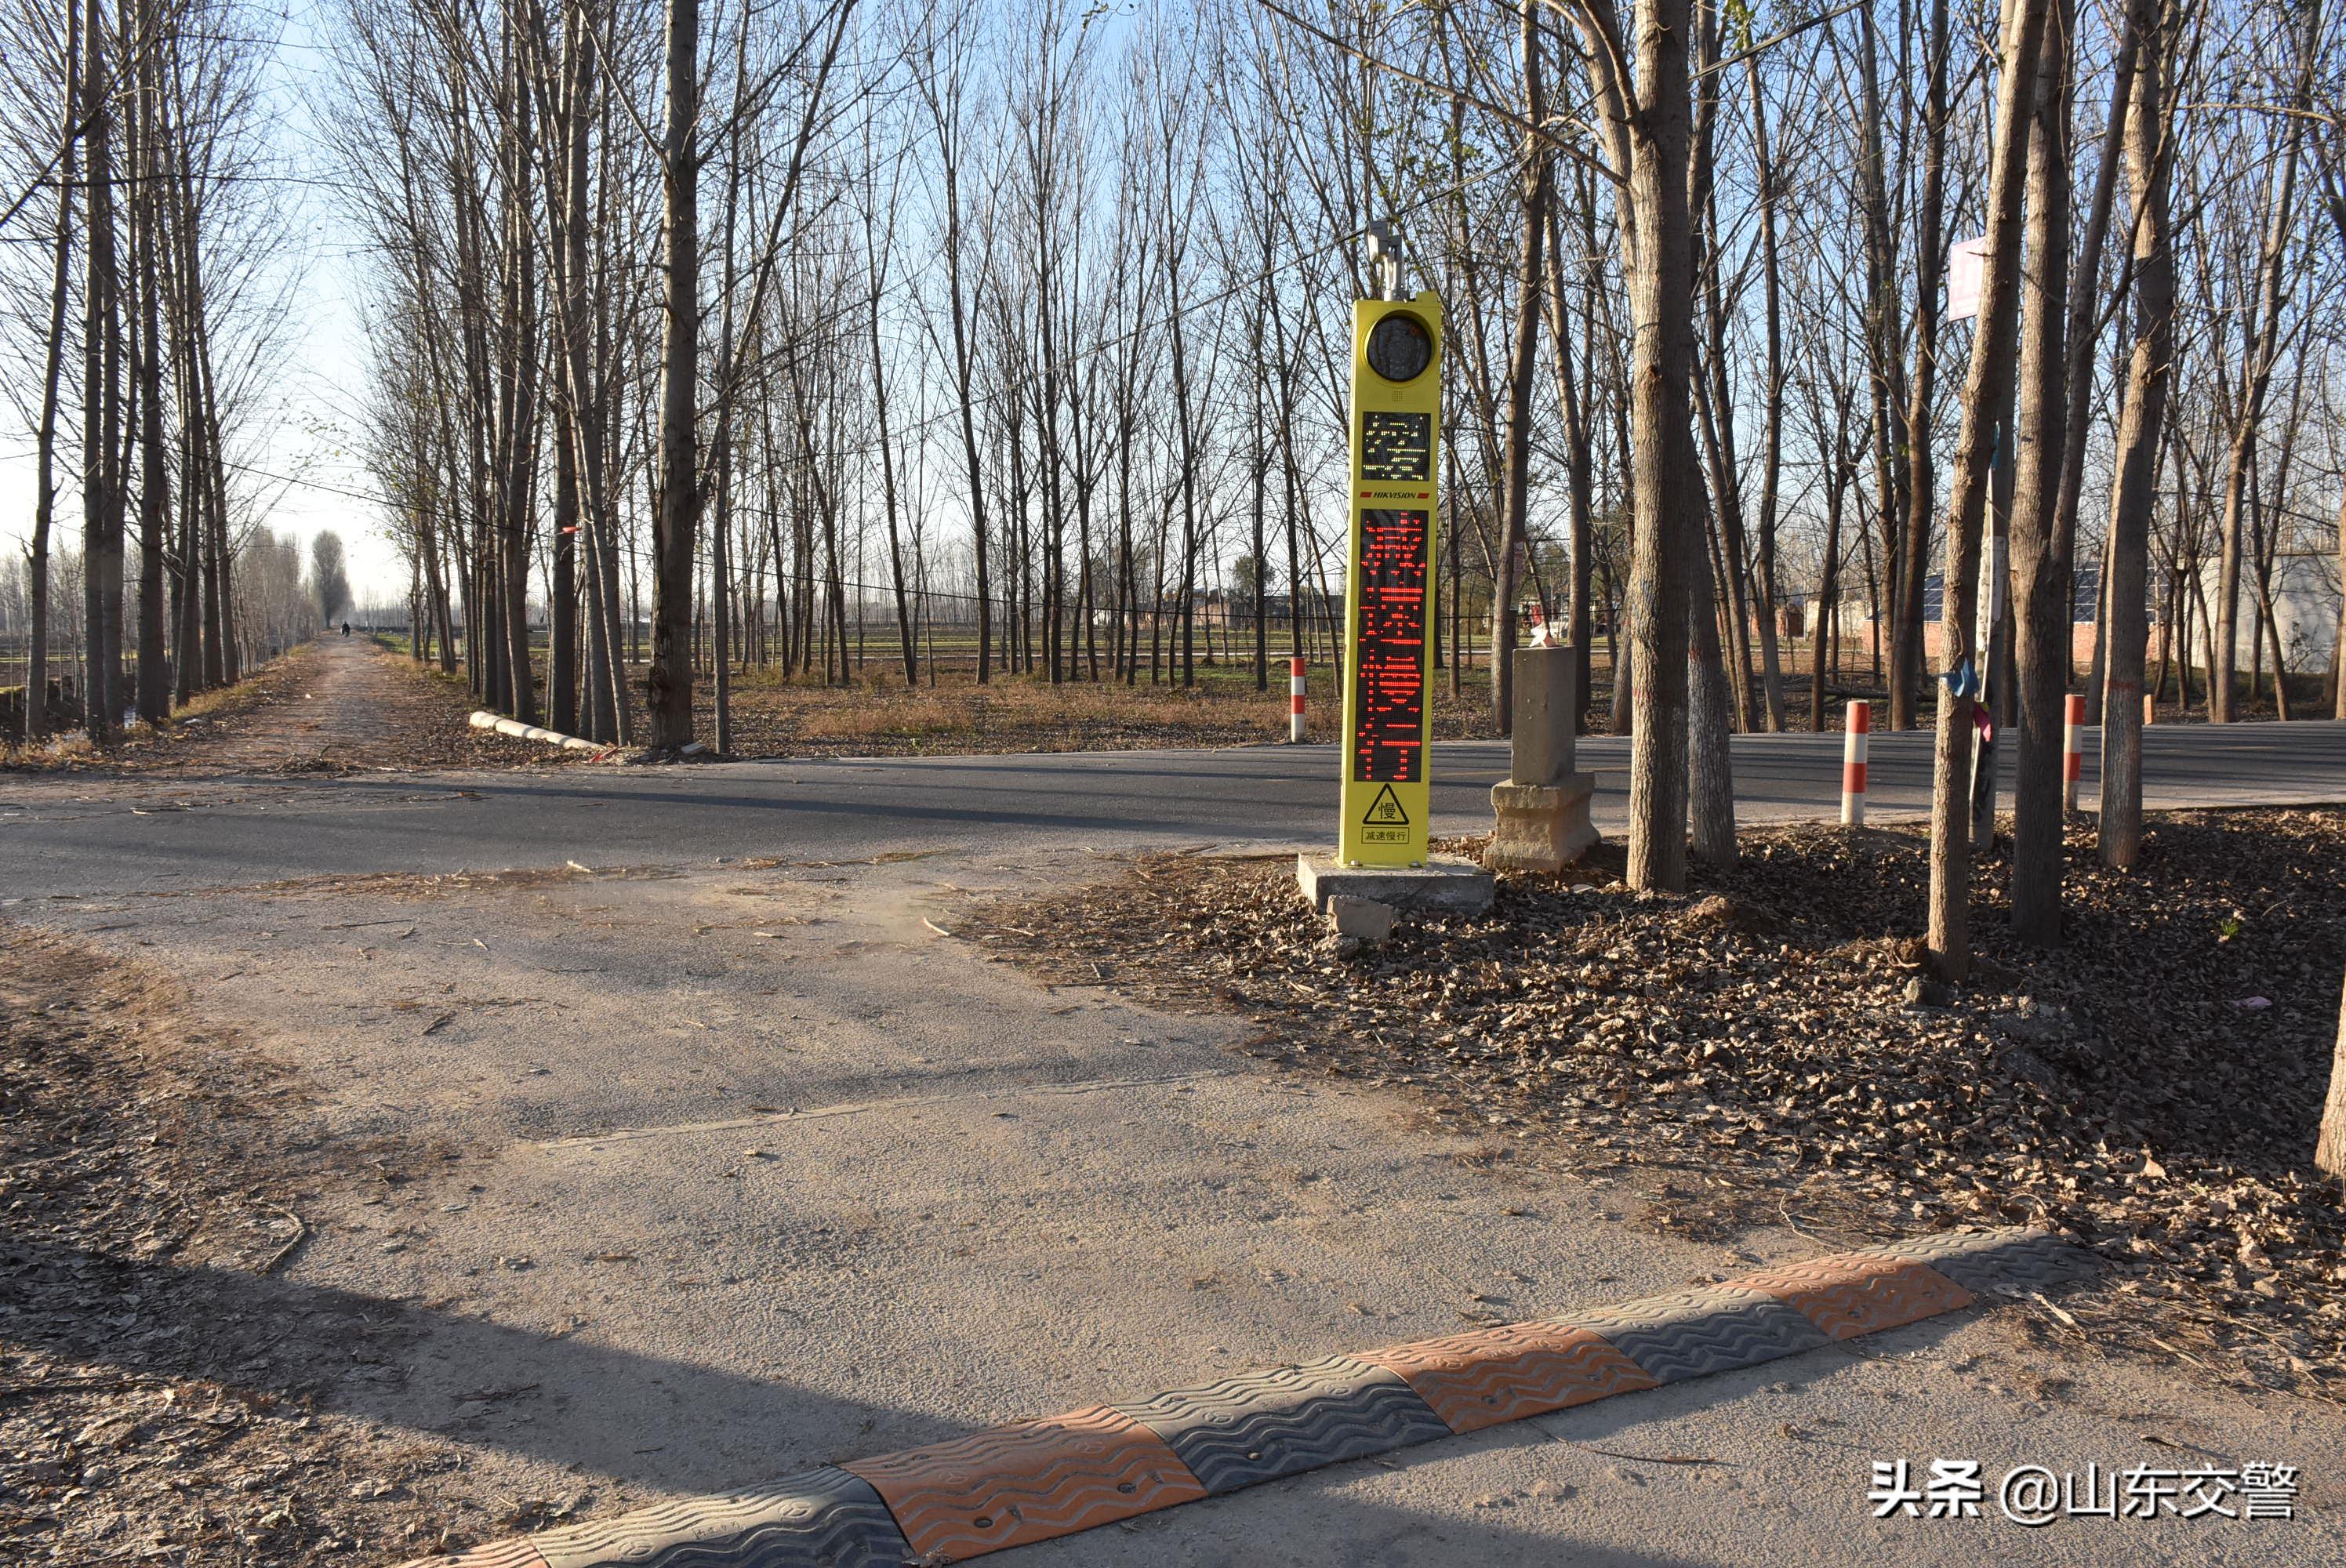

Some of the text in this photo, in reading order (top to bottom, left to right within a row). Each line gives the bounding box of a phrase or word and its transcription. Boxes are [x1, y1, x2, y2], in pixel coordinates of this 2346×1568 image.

[1378, 803, 1396, 819] 慢
[1366, 831, 1406, 841] 减速慢行
